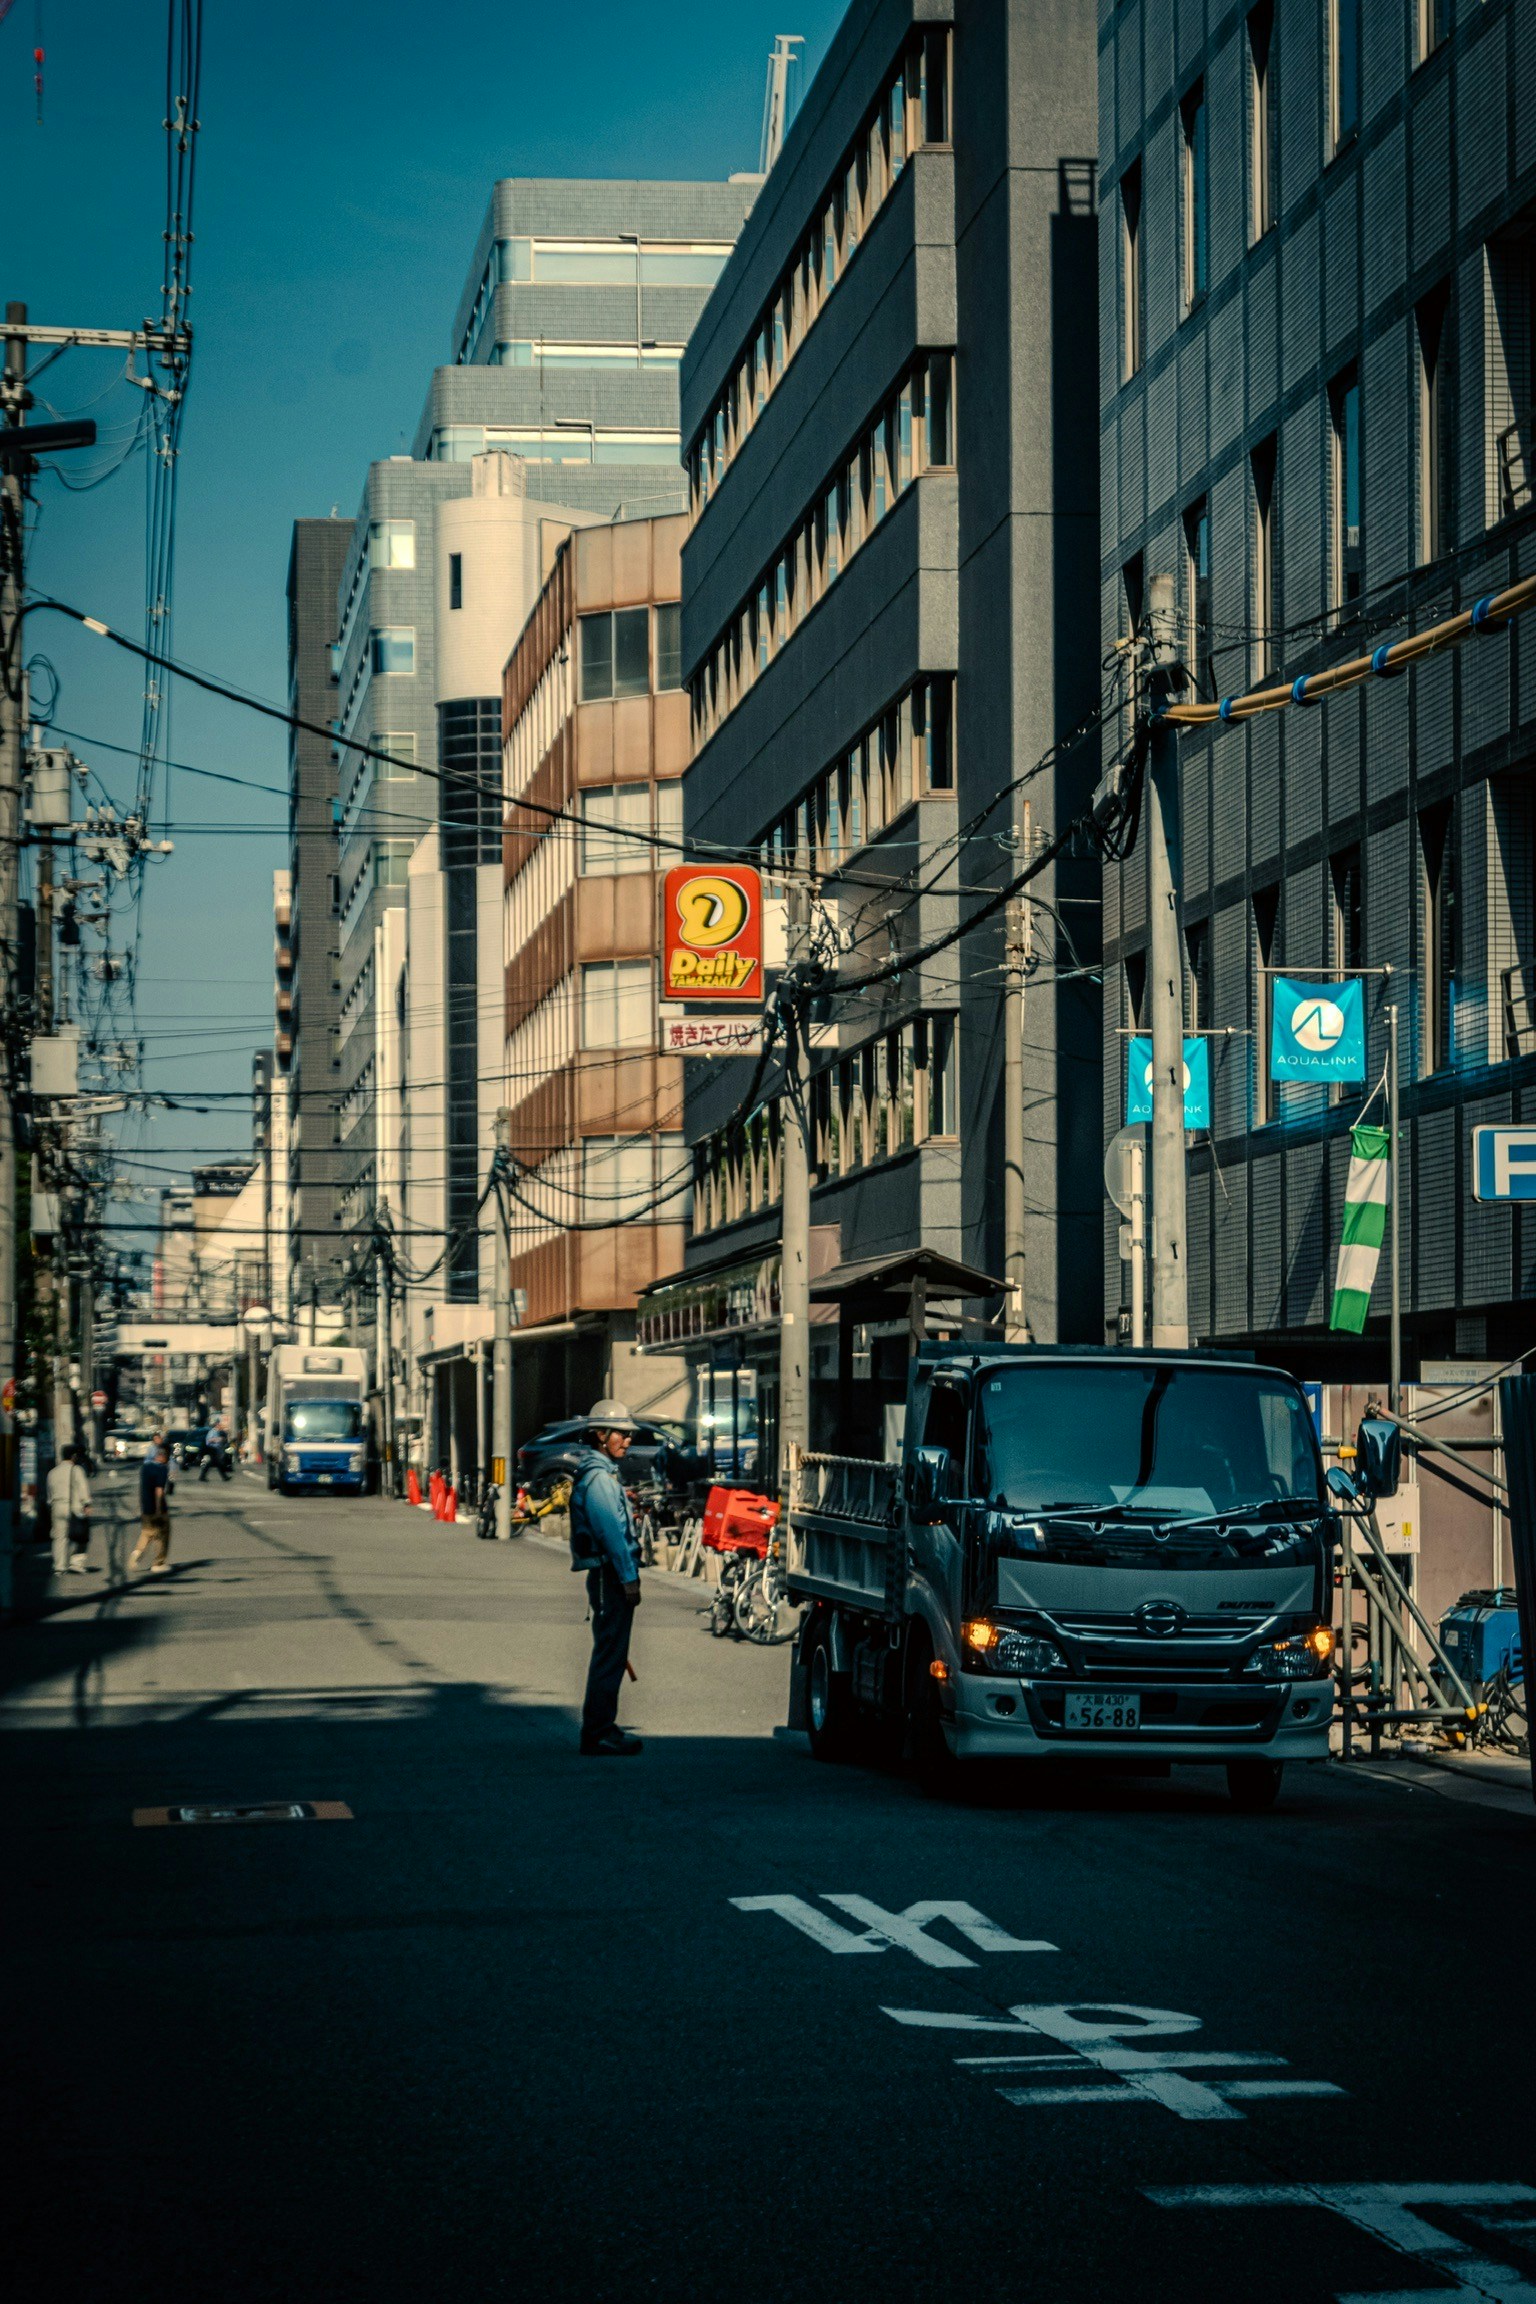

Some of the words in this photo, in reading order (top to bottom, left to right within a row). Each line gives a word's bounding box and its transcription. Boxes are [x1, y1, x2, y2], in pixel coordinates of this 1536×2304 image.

[671, 951, 759, 988] Daily
[672, 975, 738, 989] YAMAZAKI
[670, 1023, 755, 1047] 焼きたてパン
[1276, 1055, 1358, 1066] AQUALINK
[1081, 1708, 1135, 1728] 56-88
